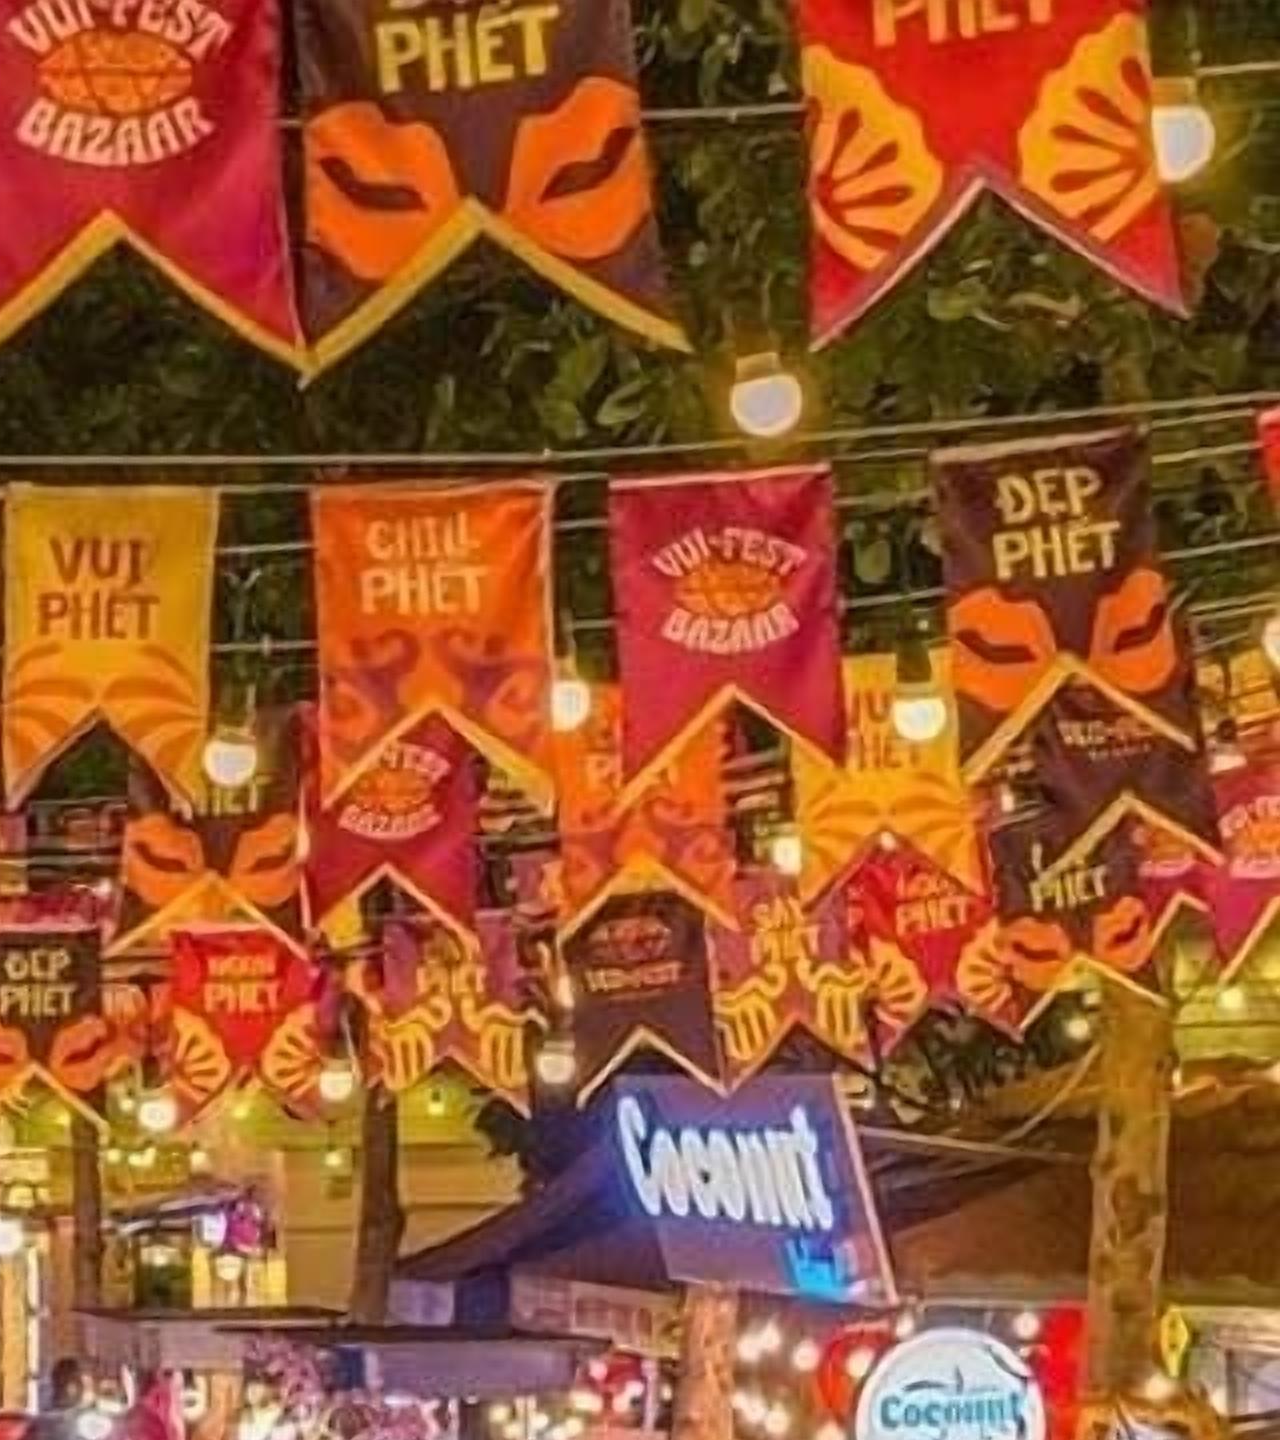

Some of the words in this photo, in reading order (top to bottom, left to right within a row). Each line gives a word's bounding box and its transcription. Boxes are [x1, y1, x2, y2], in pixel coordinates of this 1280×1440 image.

[16, 97, 215, 167] BAZAAR
[49, 535, 154, 588] VUI
[660, 602, 801, 656] BAZAAR
